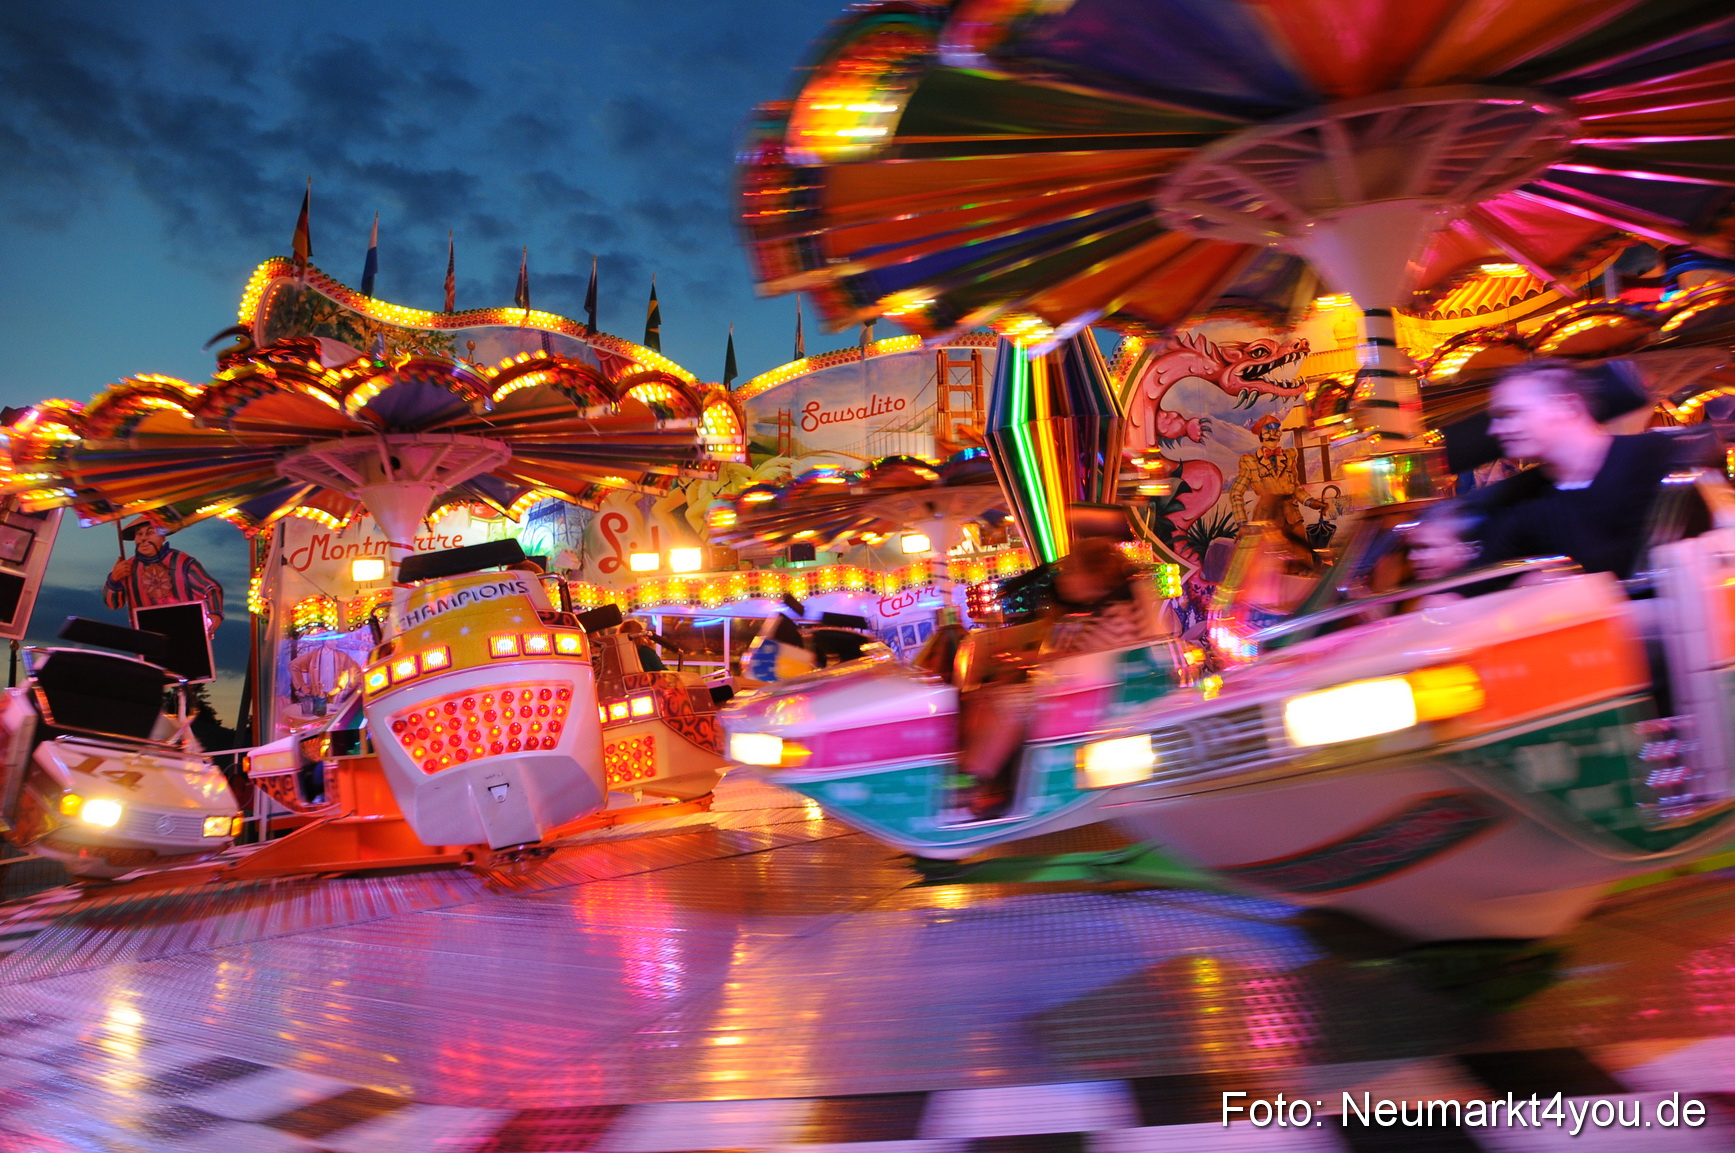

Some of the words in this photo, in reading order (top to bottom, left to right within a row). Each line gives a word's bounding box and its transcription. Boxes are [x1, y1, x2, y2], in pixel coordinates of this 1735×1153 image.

[801, 394, 906, 433] Sausalito
[289, 533, 465, 573] Montmrtre
[876, 586, 940, 618] Castr
